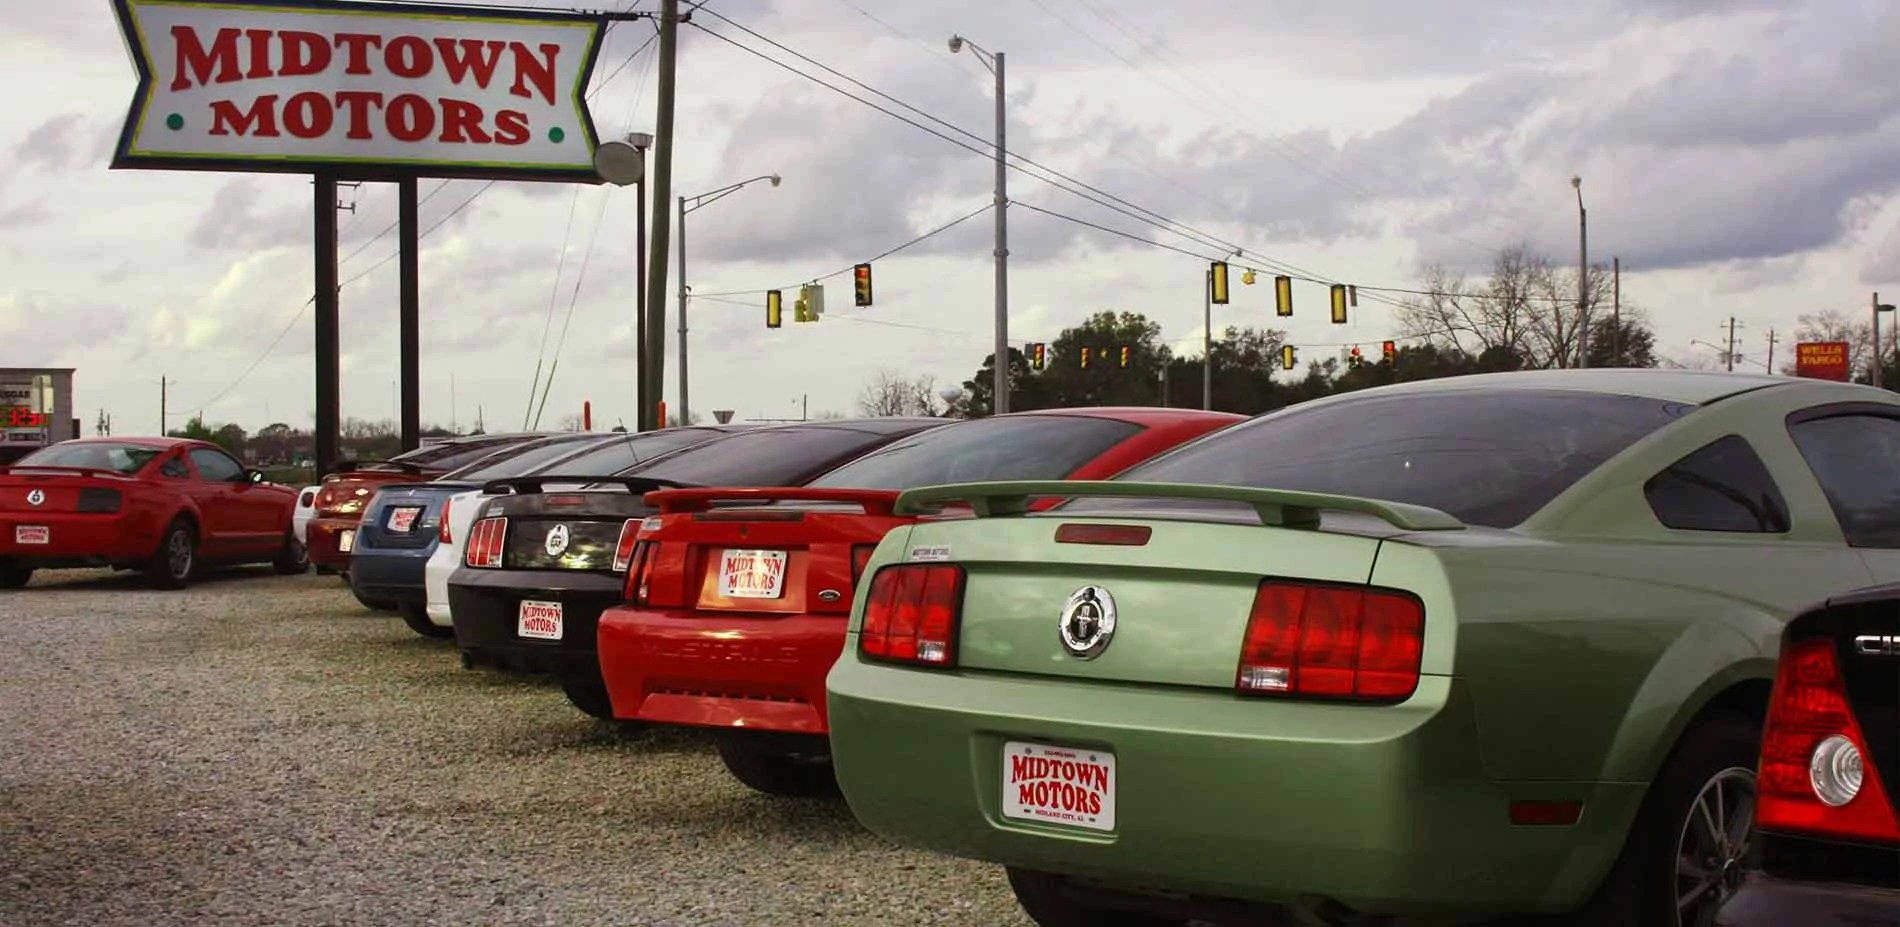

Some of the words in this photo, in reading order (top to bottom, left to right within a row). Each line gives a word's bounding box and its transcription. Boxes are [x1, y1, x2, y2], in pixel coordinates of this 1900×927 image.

[170, 25, 560, 106] MIDTOWN
[209, 91, 531, 146] MOTORS
[1800, 344, 1842, 355] WELLS
[1801, 355, 1843, 366] FARGO
[725, 557, 782, 577] MIDTWN
[728, 572, 776, 590] MOTORS
[522, 606, 561, 622] MIDTOWN
[524, 618, 558, 633] MOTORS
[1854, 634, 1900, 656] CI
[1011, 754, 1109, 796] MIDTOWN
[1019, 780, 1101, 815] MOTORS
